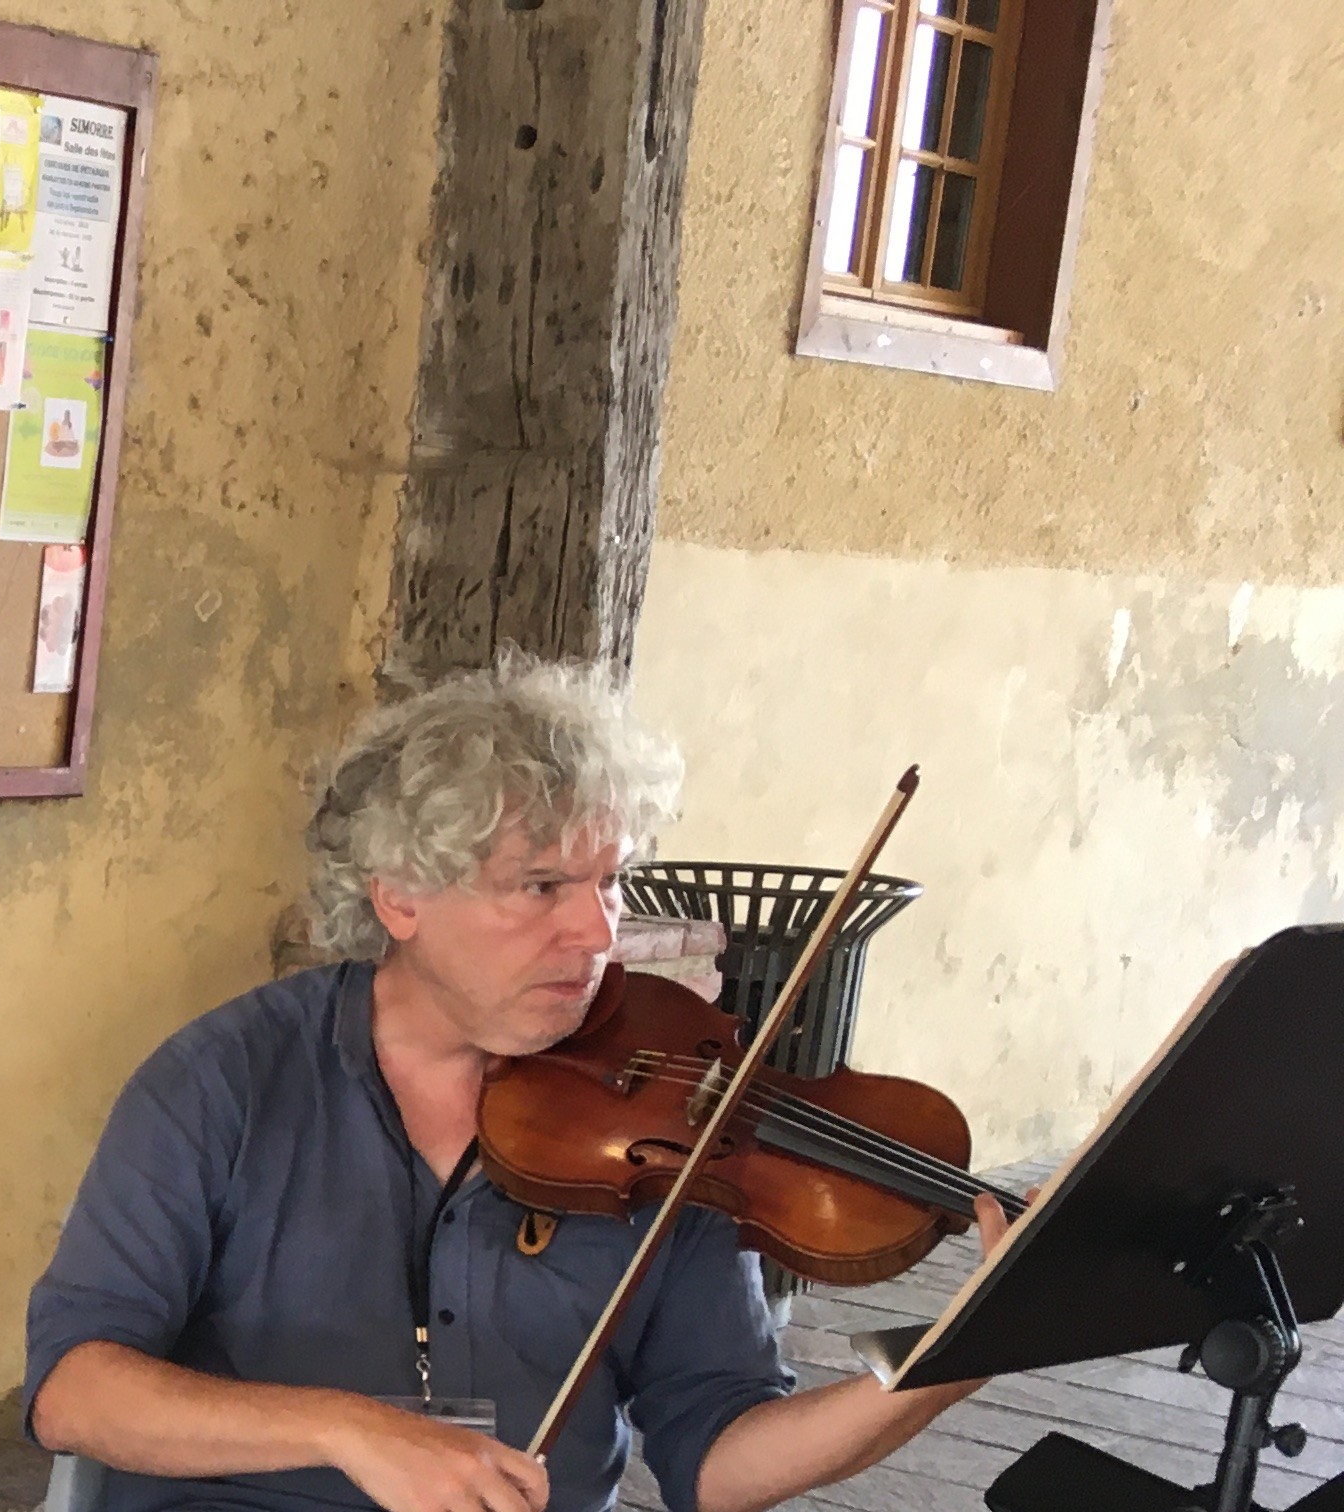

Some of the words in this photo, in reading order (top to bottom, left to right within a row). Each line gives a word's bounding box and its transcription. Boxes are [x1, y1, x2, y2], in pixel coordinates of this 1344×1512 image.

[70, 118, 114, 140] SIMORRE
[64, 141, 83, 154] Salle
[85, 145, 98, 157] des
